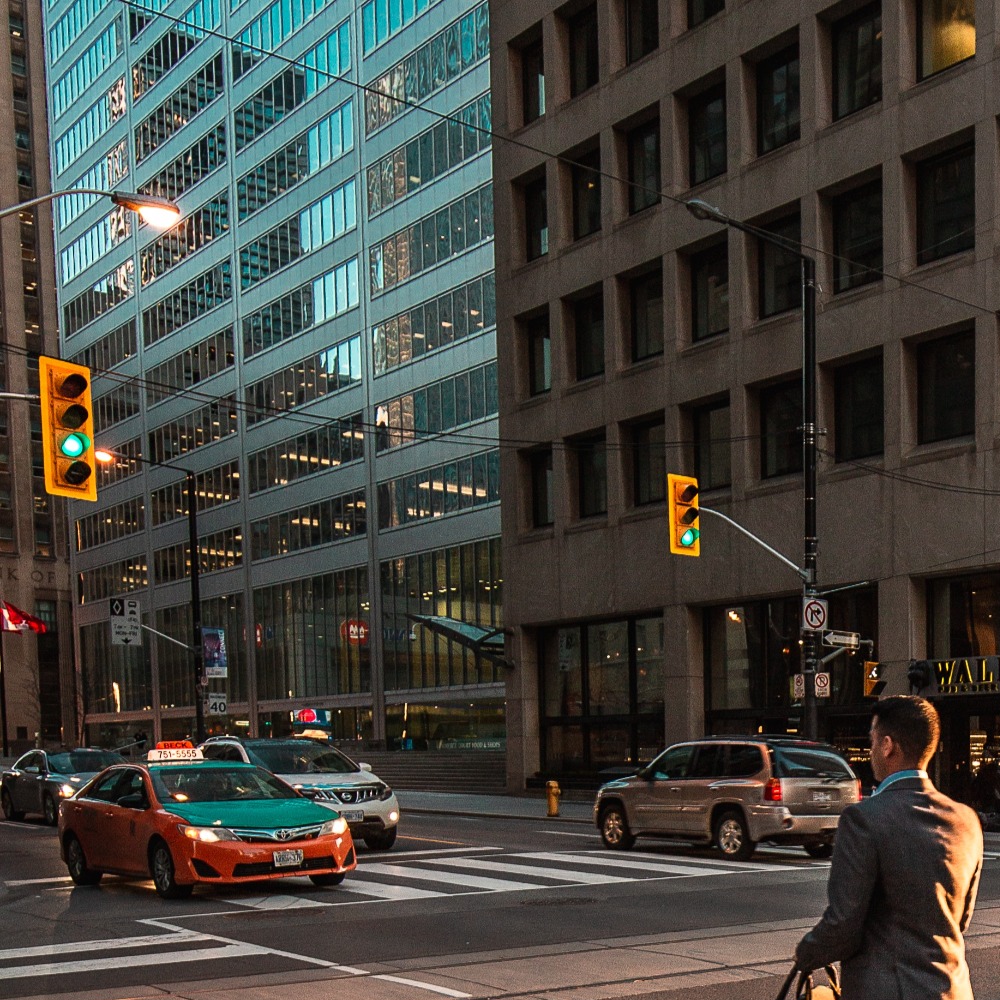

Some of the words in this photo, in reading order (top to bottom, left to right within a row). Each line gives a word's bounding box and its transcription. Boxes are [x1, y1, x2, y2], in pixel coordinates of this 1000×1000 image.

[31, 570, 56, 583] OF
[210, 702, 226, 712] 40
[158, 750, 197, 759] 751-5555
